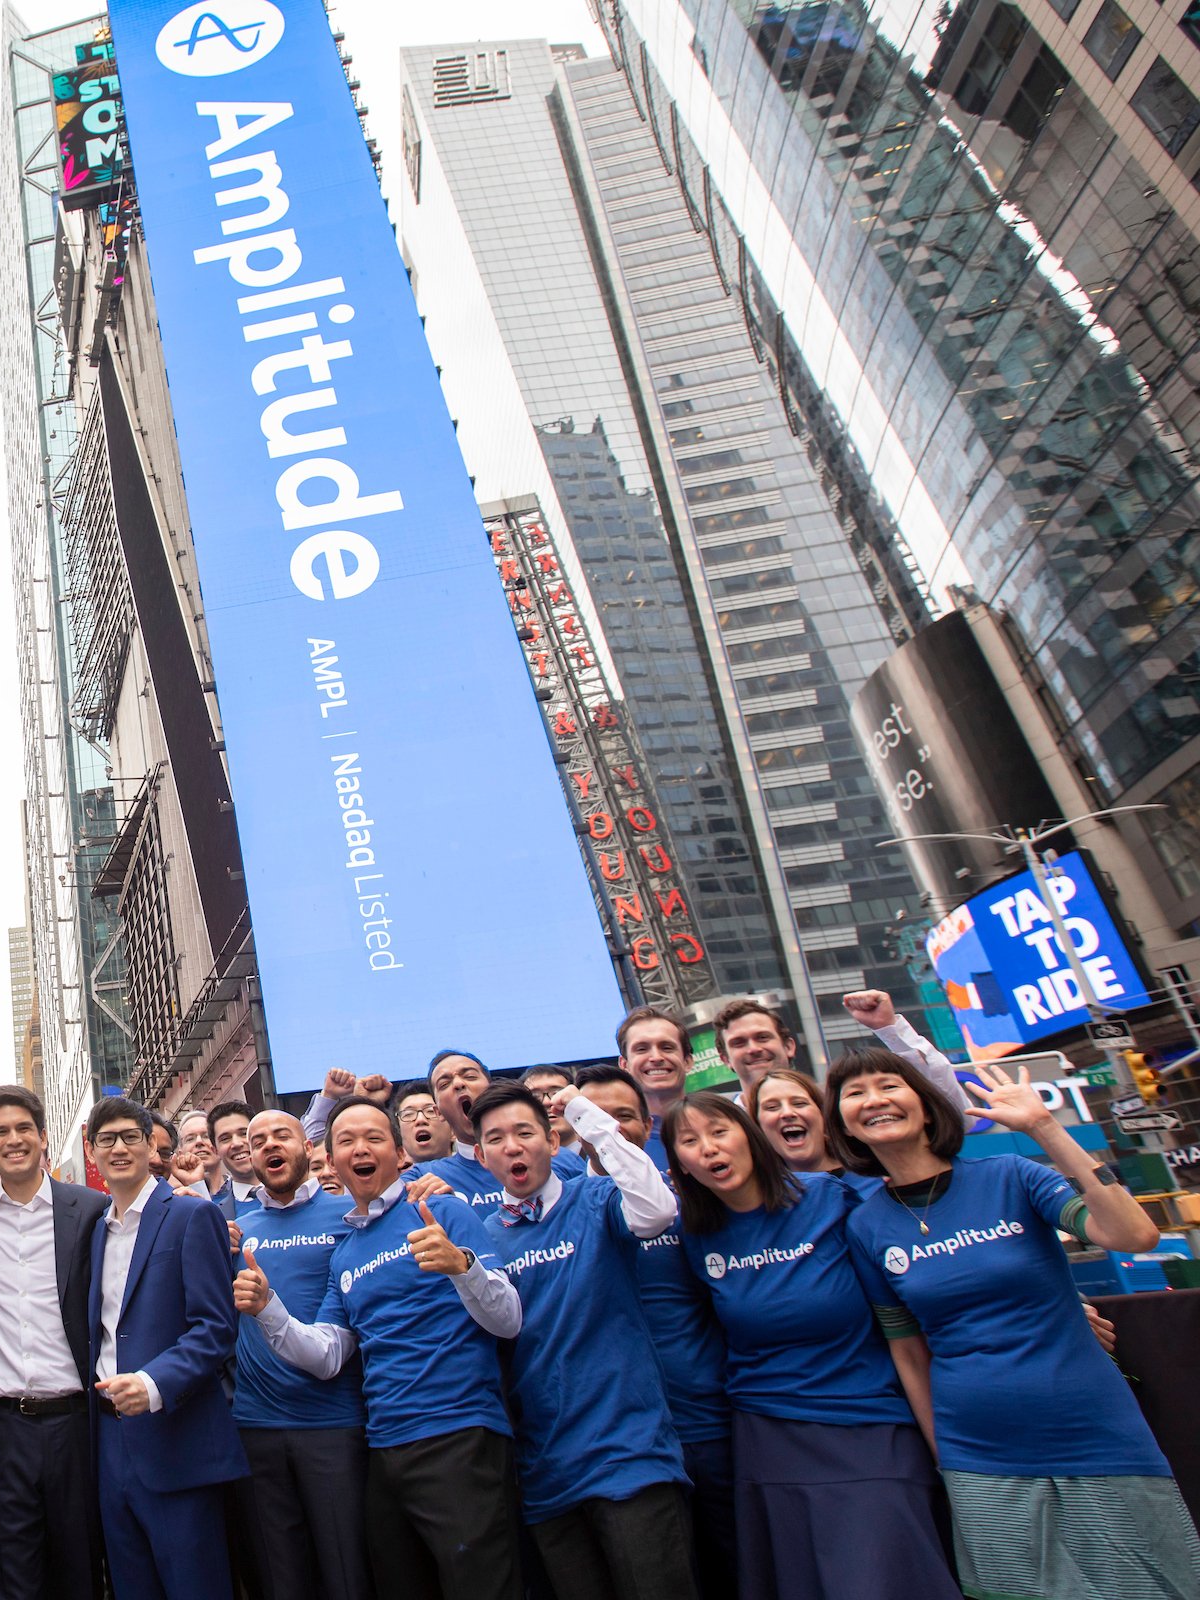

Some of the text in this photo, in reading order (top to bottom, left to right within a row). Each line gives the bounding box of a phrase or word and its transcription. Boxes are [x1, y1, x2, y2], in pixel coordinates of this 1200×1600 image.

[193, 101, 405, 601] Amplitude
[491, 531, 549, 676] ERNST
[573, 772, 659, 969] YOUNG
[306, 637, 405, 972] AMPL Nasdaq Listed
[989, 875, 1077, 938] TAP
[1023, 916, 1100, 970] TO
[1012, 954, 1126, 1026] RIDE
[259, 1232, 336, 1251] Amplitude
[504, 1240, 576, 1279] mplitude
[727, 1241, 815, 1271] Amplitude
[912, 1219, 1025, 1262] Amplitude
